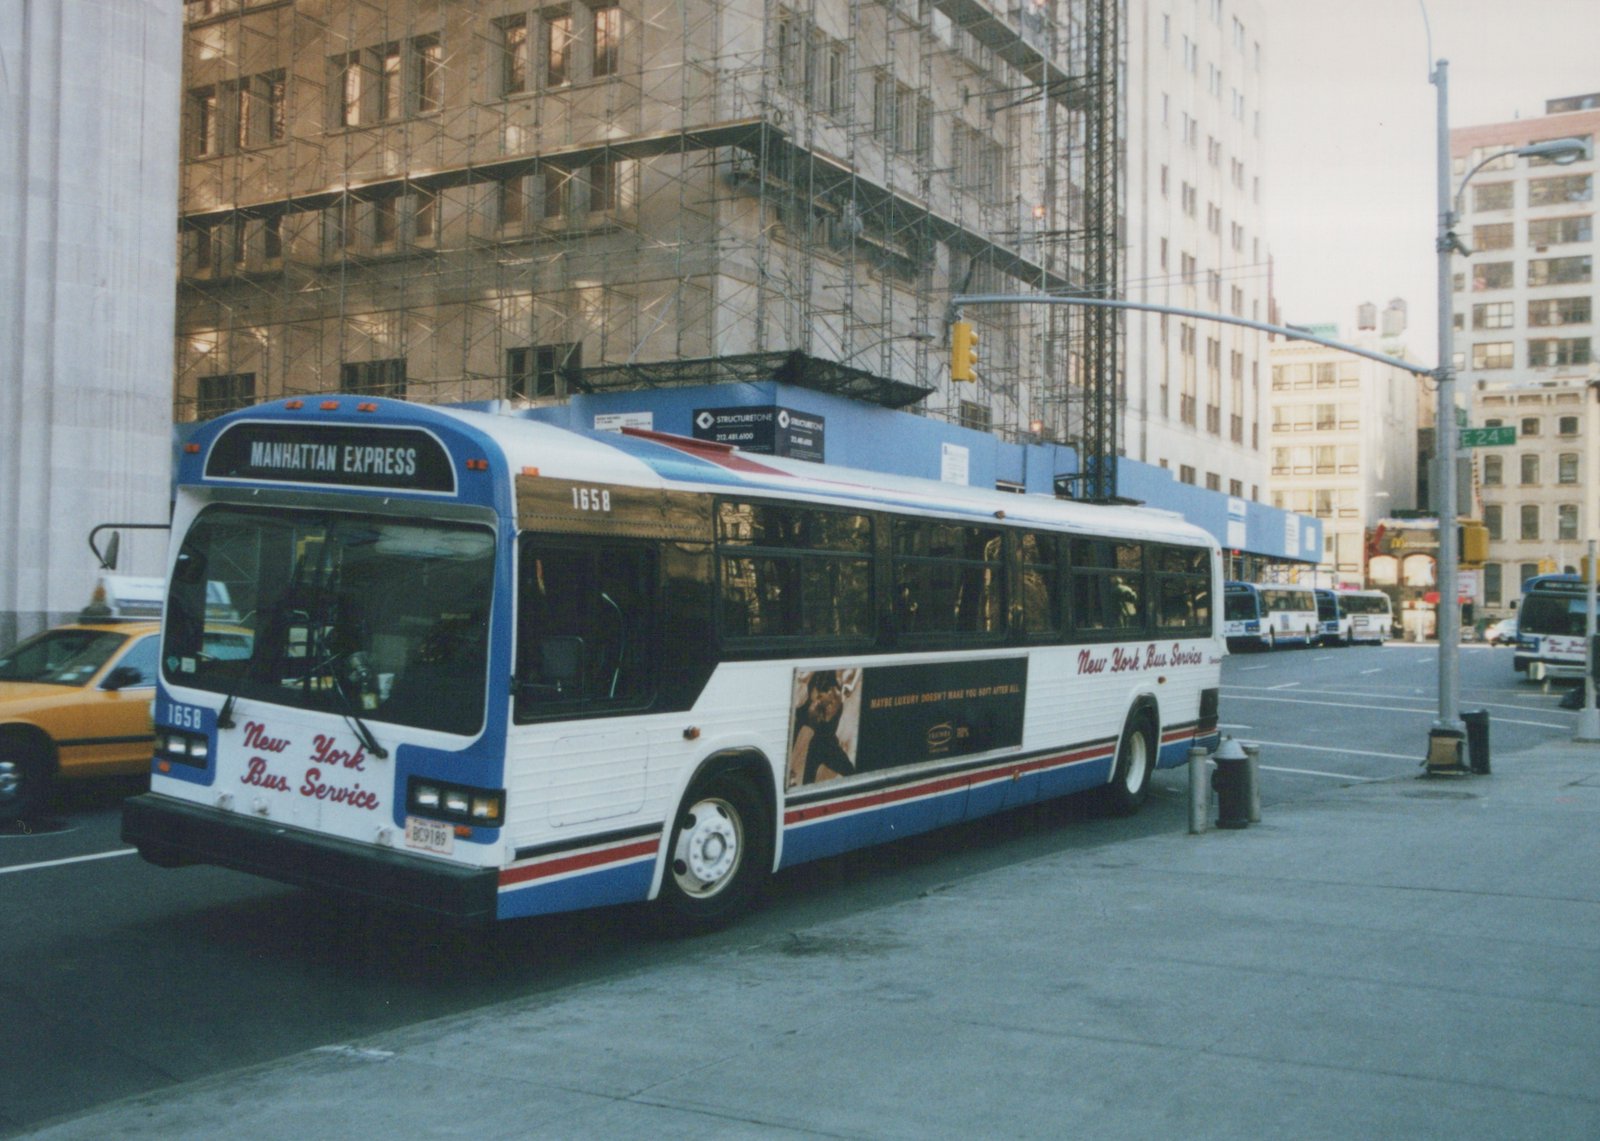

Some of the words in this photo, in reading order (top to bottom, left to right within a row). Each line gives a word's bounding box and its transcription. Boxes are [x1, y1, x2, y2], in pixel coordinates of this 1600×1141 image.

[1462, 432, 1473, 446] E
[1476, 430, 1500, 445] 24
[250, 441, 337, 470] MANHATTAN
[343, 446, 417, 476] EXPRESS
[571, 487, 612, 512] 1658
[1077, 649, 1107, 675] New
[1110, 647, 1140, 673] York
[1143, 643, 1167, 670] Bus
[1170, 642, 1202, 667] Service
[168, 704, 202, 730] 1658
[243, 721, 291, 752] New
[310, 735, 366, 771] York
[241, 757, 291, 792] Bus
[301, 768, 380, 810] Service
